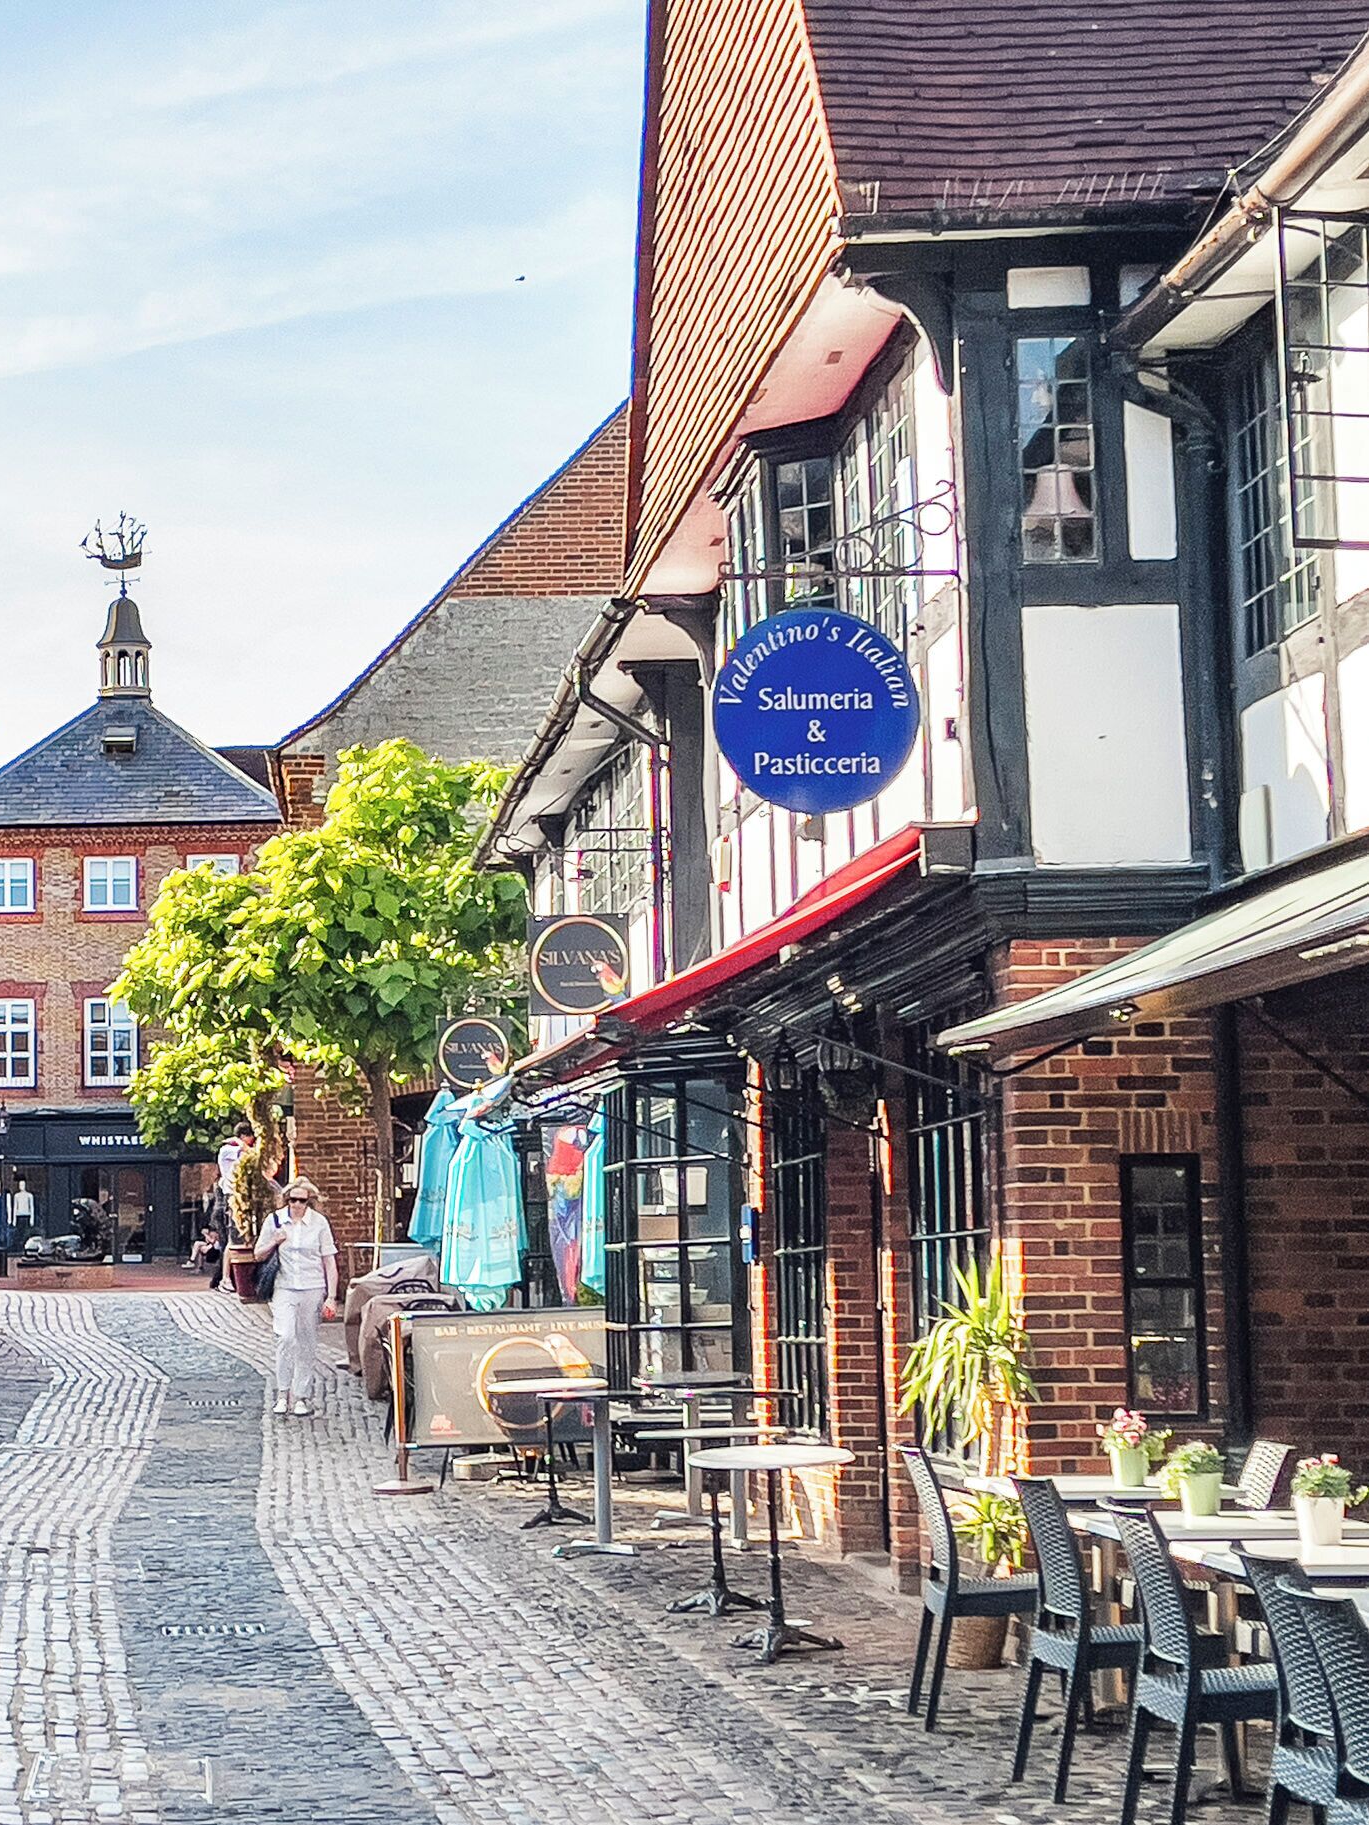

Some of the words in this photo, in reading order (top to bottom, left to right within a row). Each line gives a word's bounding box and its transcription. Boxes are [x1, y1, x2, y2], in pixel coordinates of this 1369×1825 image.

[719, 617, 841, 705] Valentino's
[845, 627, 910, 709] Italian
[758, 687, 873, 710] Salumeria
[807, 720, 826, 742] &
[754, 752, 881, 775] Pasticceria
